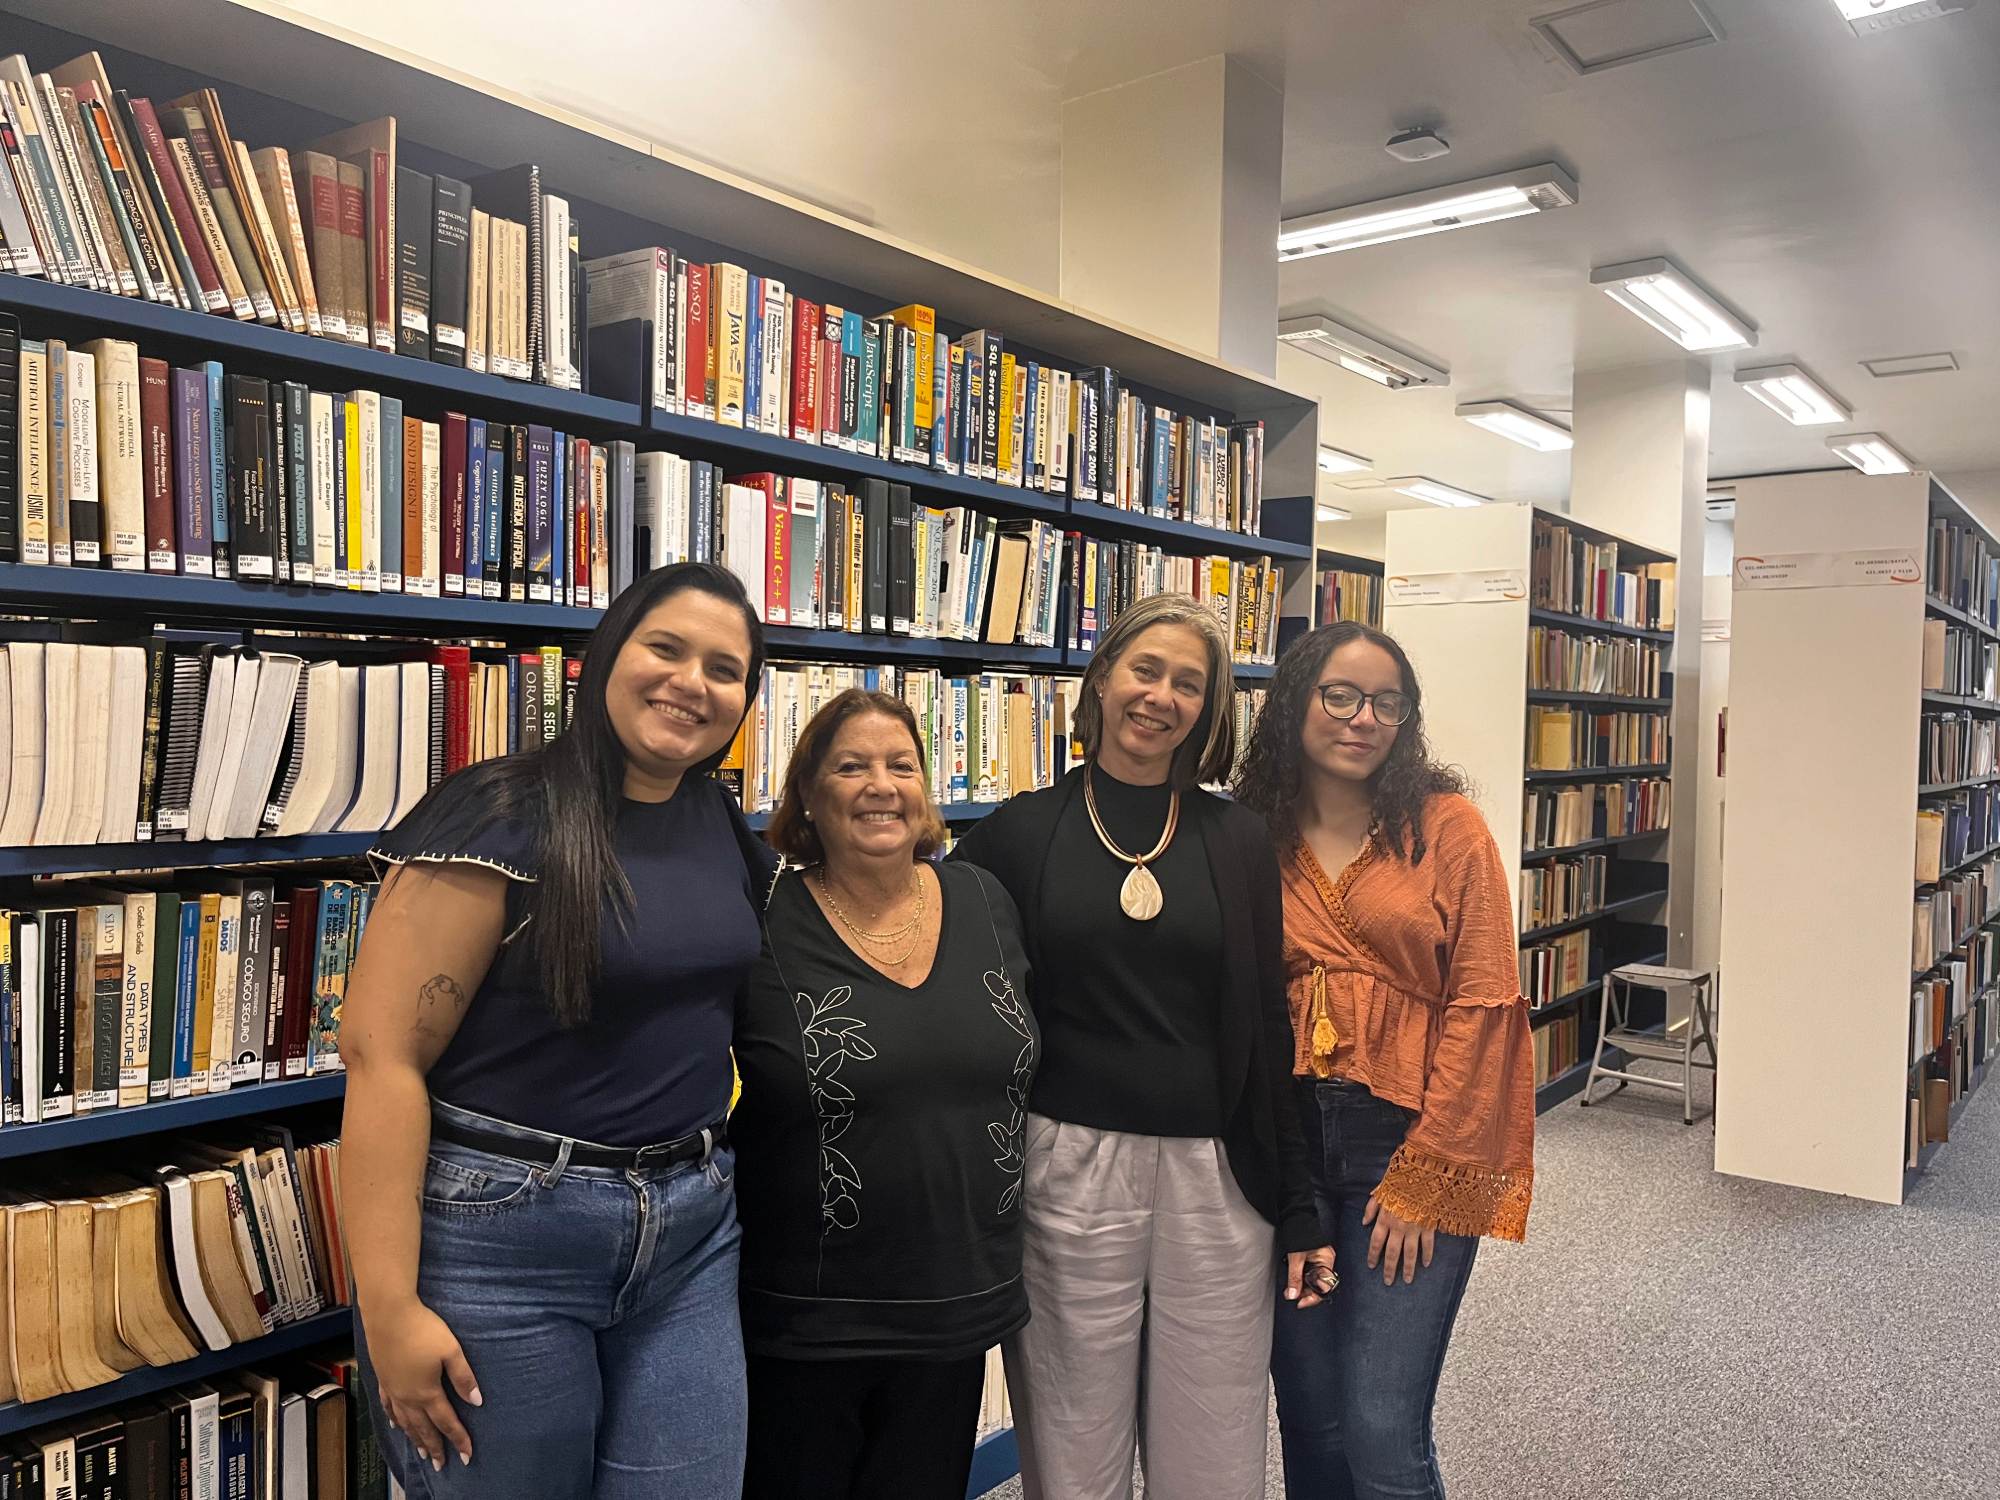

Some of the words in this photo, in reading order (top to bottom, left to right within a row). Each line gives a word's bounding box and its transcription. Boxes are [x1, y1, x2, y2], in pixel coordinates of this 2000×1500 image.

[49, 187, 69, 238] METODOLOGIA
[177, 142, 186, 155] OF
[183, 156, 205, 207] OPERATIONS
[202, 207, 222, 252] RESEARCH
[438, 229, 465, 241] RESEARCH
[657, 274, 667, 334] Programming
[691, 270, 702, 325] MySQL
[659, 335, 667, 355] with
[727, 309, 742, 346] JAVA
[809, 325, 818, 365] Assembly
[668, 349, 675, 357] 7
[919, 331, 932, 385] JavaScript
[988, 344, 997, 366] SQL
[28, 358, 39, 414] ARTIFICIAL
[76, 362, 86, 388] Cooper
[145, 376, 167, 386] HUNT
[807, 368, 817, 408] Language
[864, 339, 876, 408] JavaScript
[971, 375, 983, 397] ADO
[988, 369, 997, 407] Server
[117, 380, 125, 411] NEURAL
[72, 398, 82, 445] COGNITIVE
[81, 399, 91, 445] MODELLING
[118, 414, 126, 458] NETWORKS
[127, 416, 135, 459] ARTIFICIAL
[191, 407, 204, 462] Neuro-Fuzzy
[213, 407, 223, 455] Foundations
[315, 421, 323, 443] Theory
[323, 412, 331, 433] Fuzzy
[987, 409, 996, 438] 2000
[1088, 404, 1098, 453] OUTLOOK
[1107, 416, 1115, 453] Windows
[29, 416, 41, 489] INTELLIGENCE
[293, 424, 305, 461] FUZZY
[407, 422, 417, 458] MIND
[532, 444, 550, 452] ROSS
[1158, 436, 1166, 463] Excel
[73, 447, 82, 488] PROCESSES
[82, 449, 91, 493] HIGH-LEVEL
[215, 456, 224, 466] of
[430, 466, 439, 479] The
[472, 459, 482, 493] Cognitive
[540, 460, 548, 492] FUZZY
[1088, 455, 1098, 482] 2002
[194, 478, 203, 495] Soft
[214, 469, 224, 492] Fuzzy
[316, 459, 324, 501] Applications
[407, 460, 417, 502] DESIGN
[490, 469, 498, 506] Artificial
[595, 465, 603, 519] INTELIGÊNCIA
[27, 494, 43, 519] USING
[216, 494, 226, 522] Control
[295, 464, 307, 545] ENGINEERING
[408, 504, 417, 519] II
[428, 482, 439, 522] Psychology
[472, 495, 481, 522] Systems
[513, 475, 524, 526] INTELIGÊNCIA
[539, 496, 547, 527] LOGIC
[28, 521, 43, 534] C
[193, 497, 204, 540] Computing
[430, 524, 438, 532] of
[489, 512, 498, 556] Intelligence
[933, 525, 941, 546] SQL
[471, 523, 480, 565] Engineering
[513, 529, 523, 570] ARTIFICIAL
[773, 513, 784, 560] Visual
[932, 547, 941, 575] Server
[773, 565, 783, 599] C++
[929, 578, 938, 602] 2005
[543, 654, 555, 706] COMPUTER
[526, 672, 537, 732] ORACLE
[955, 729, 964, 742] 6
[327, 903, 333, 915] DE
[333, 903, 339, 915] DE
[337, 904, 346, 939] SISTEMA
[220, 920, 229, 952] DADOS
[324, 917, 332, 945] DADOS
[330, 916, 339, 951] BANCOS
[2, 944, 10, 963] DATA
[2, 965, 10, 994] MINING
[127, 964, 136, 992] AND
[242, 957, 256, 1002] CÓDIGO
[139, 982, 149, 1011] DATA
[216, 989, 226, 1020] SAHNI
[138, 1012, 148, 1053] TYPES
[240, 1003, 251, 1043] SEGURO
[198, 1422, 214, 1460] Software
[83, 1454, 94, 1483] MARTIN
[107, 1447, 118, 1476] MARTIN
